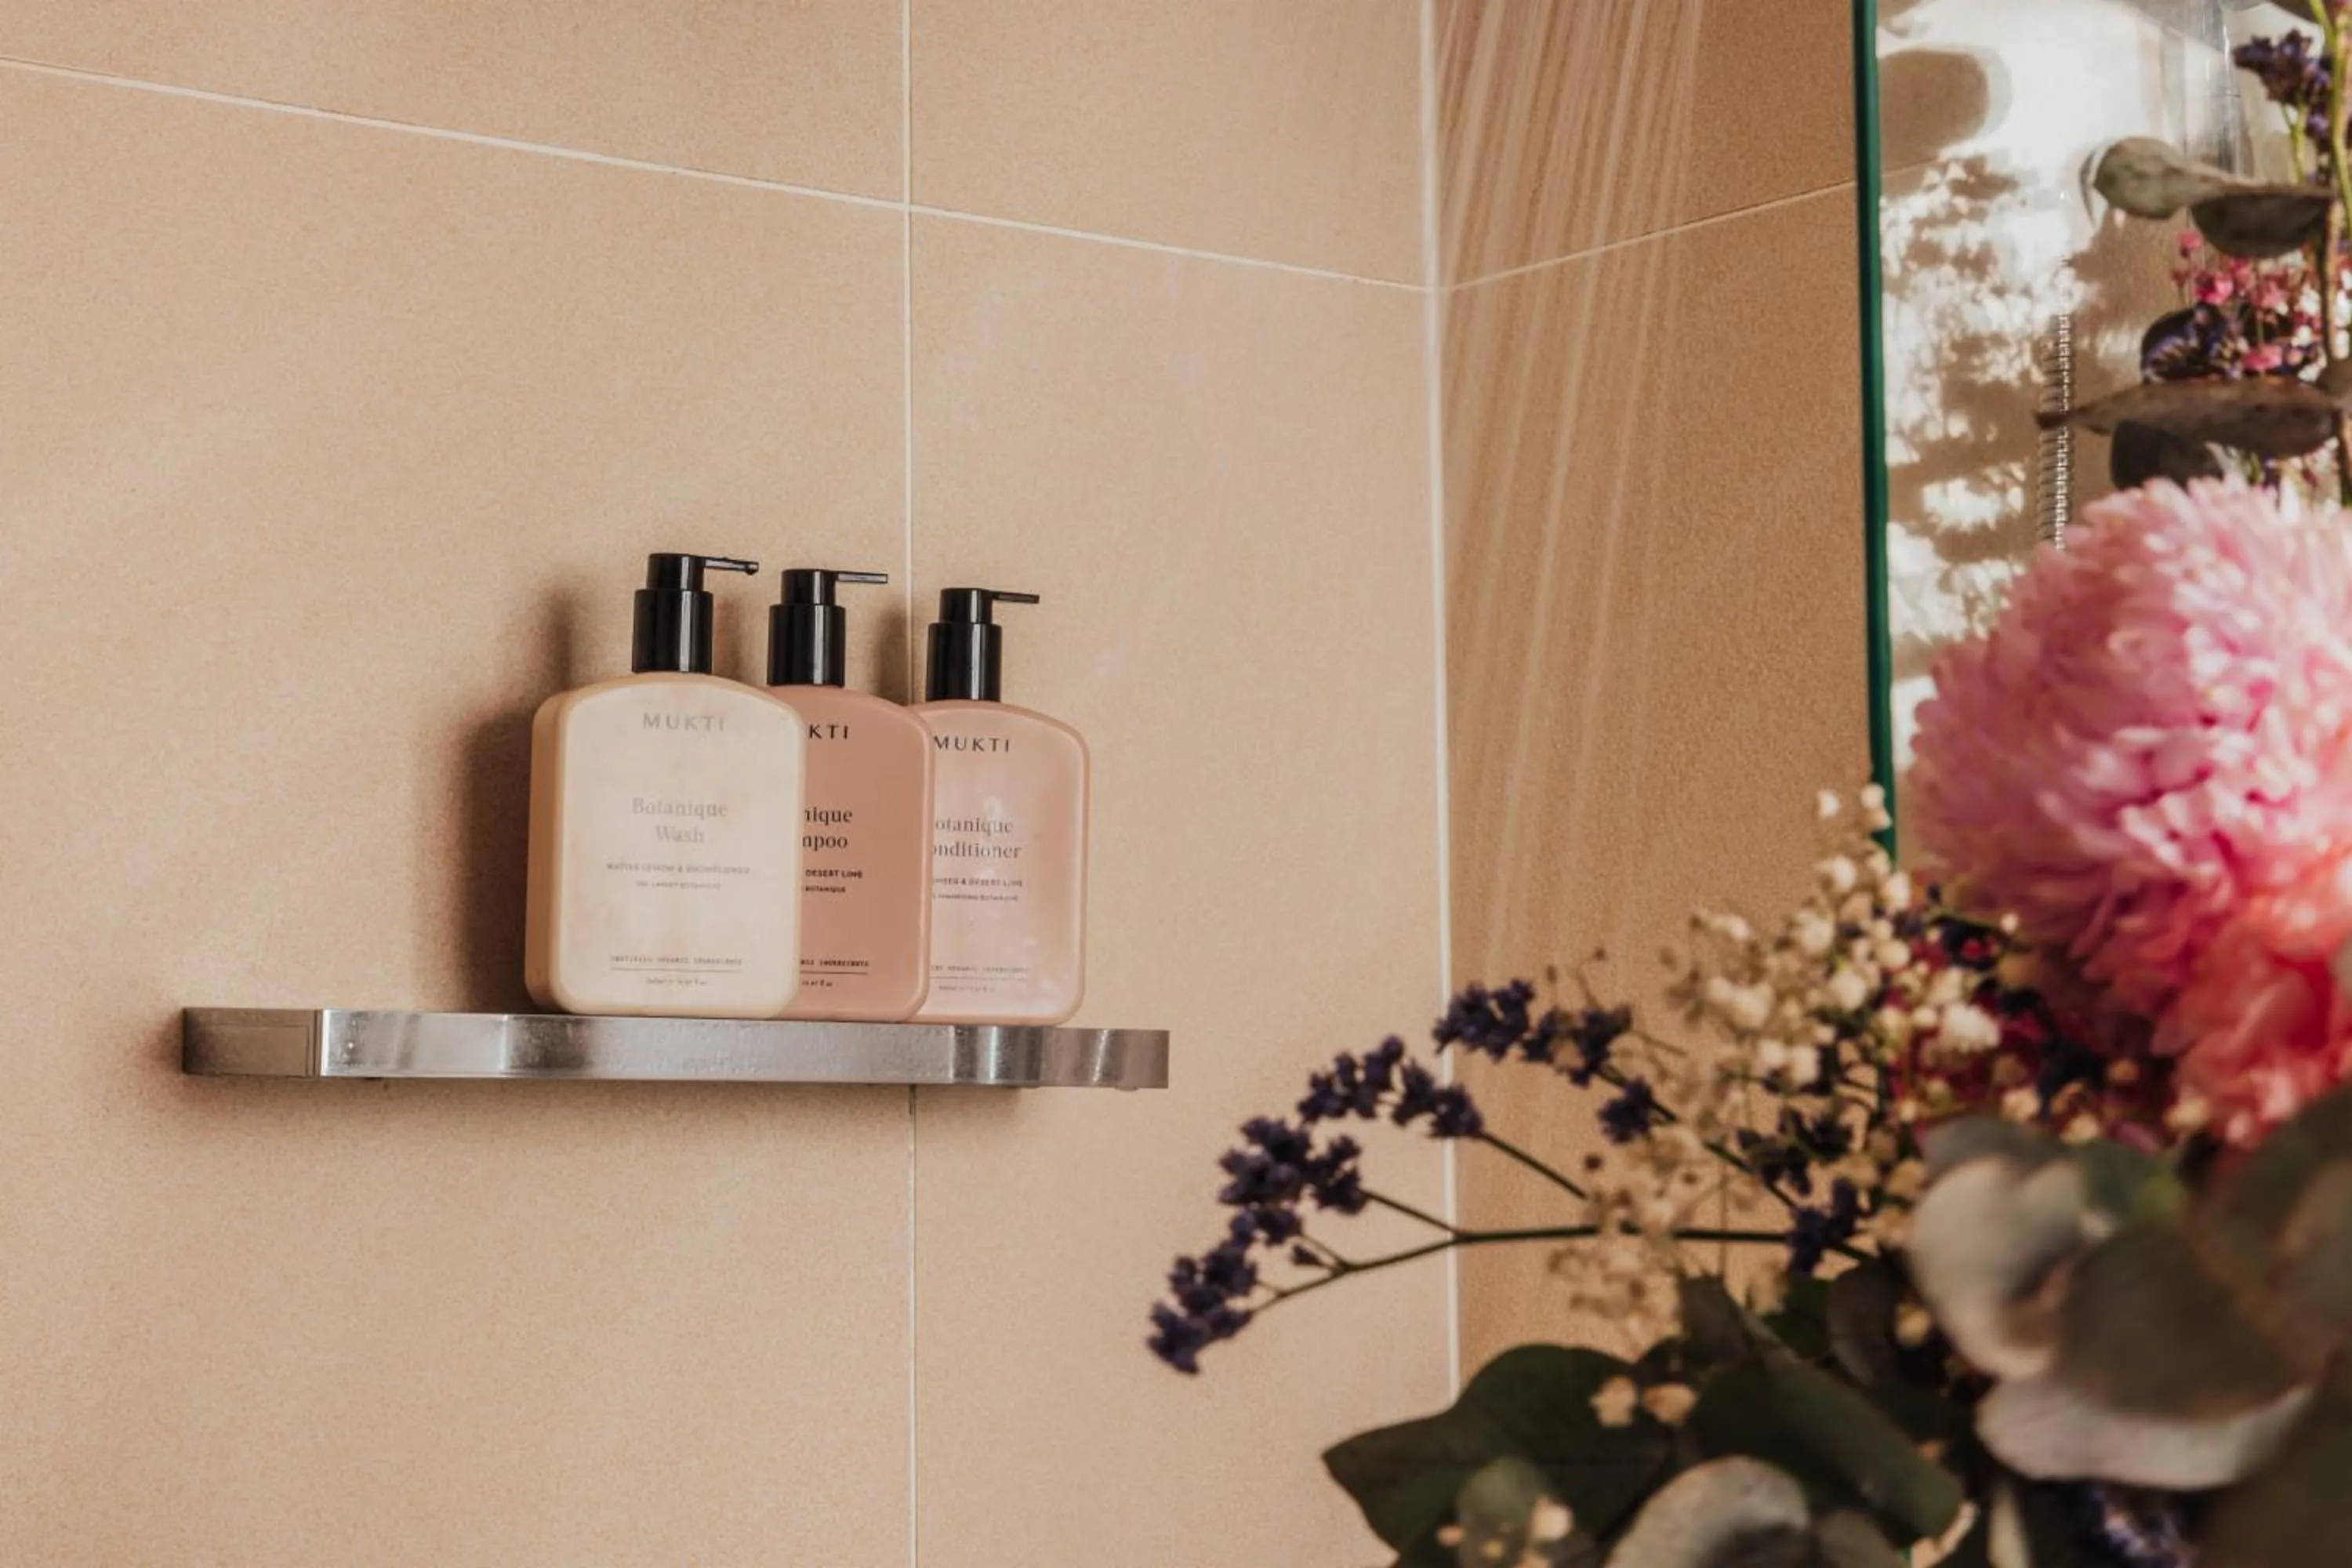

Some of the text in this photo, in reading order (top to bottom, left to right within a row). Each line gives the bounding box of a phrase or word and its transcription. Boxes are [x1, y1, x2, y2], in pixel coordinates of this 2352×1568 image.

[642, 711, 726, 732] MUKTI
[808, 723, 850, 740] KTI
[933, 735, 1011, 753] MUKTI
[631, 797, 729, 821] Botanique
[804, 806, 853, 826] nique
[655, 824, 705, 844] Wash
[935, 817, 1014, 837] otanique
[802, 834, 849, 852] mpoo
[931, 840, 1022, 860] onditioner
[804, 868, 839, 879] DESERT
